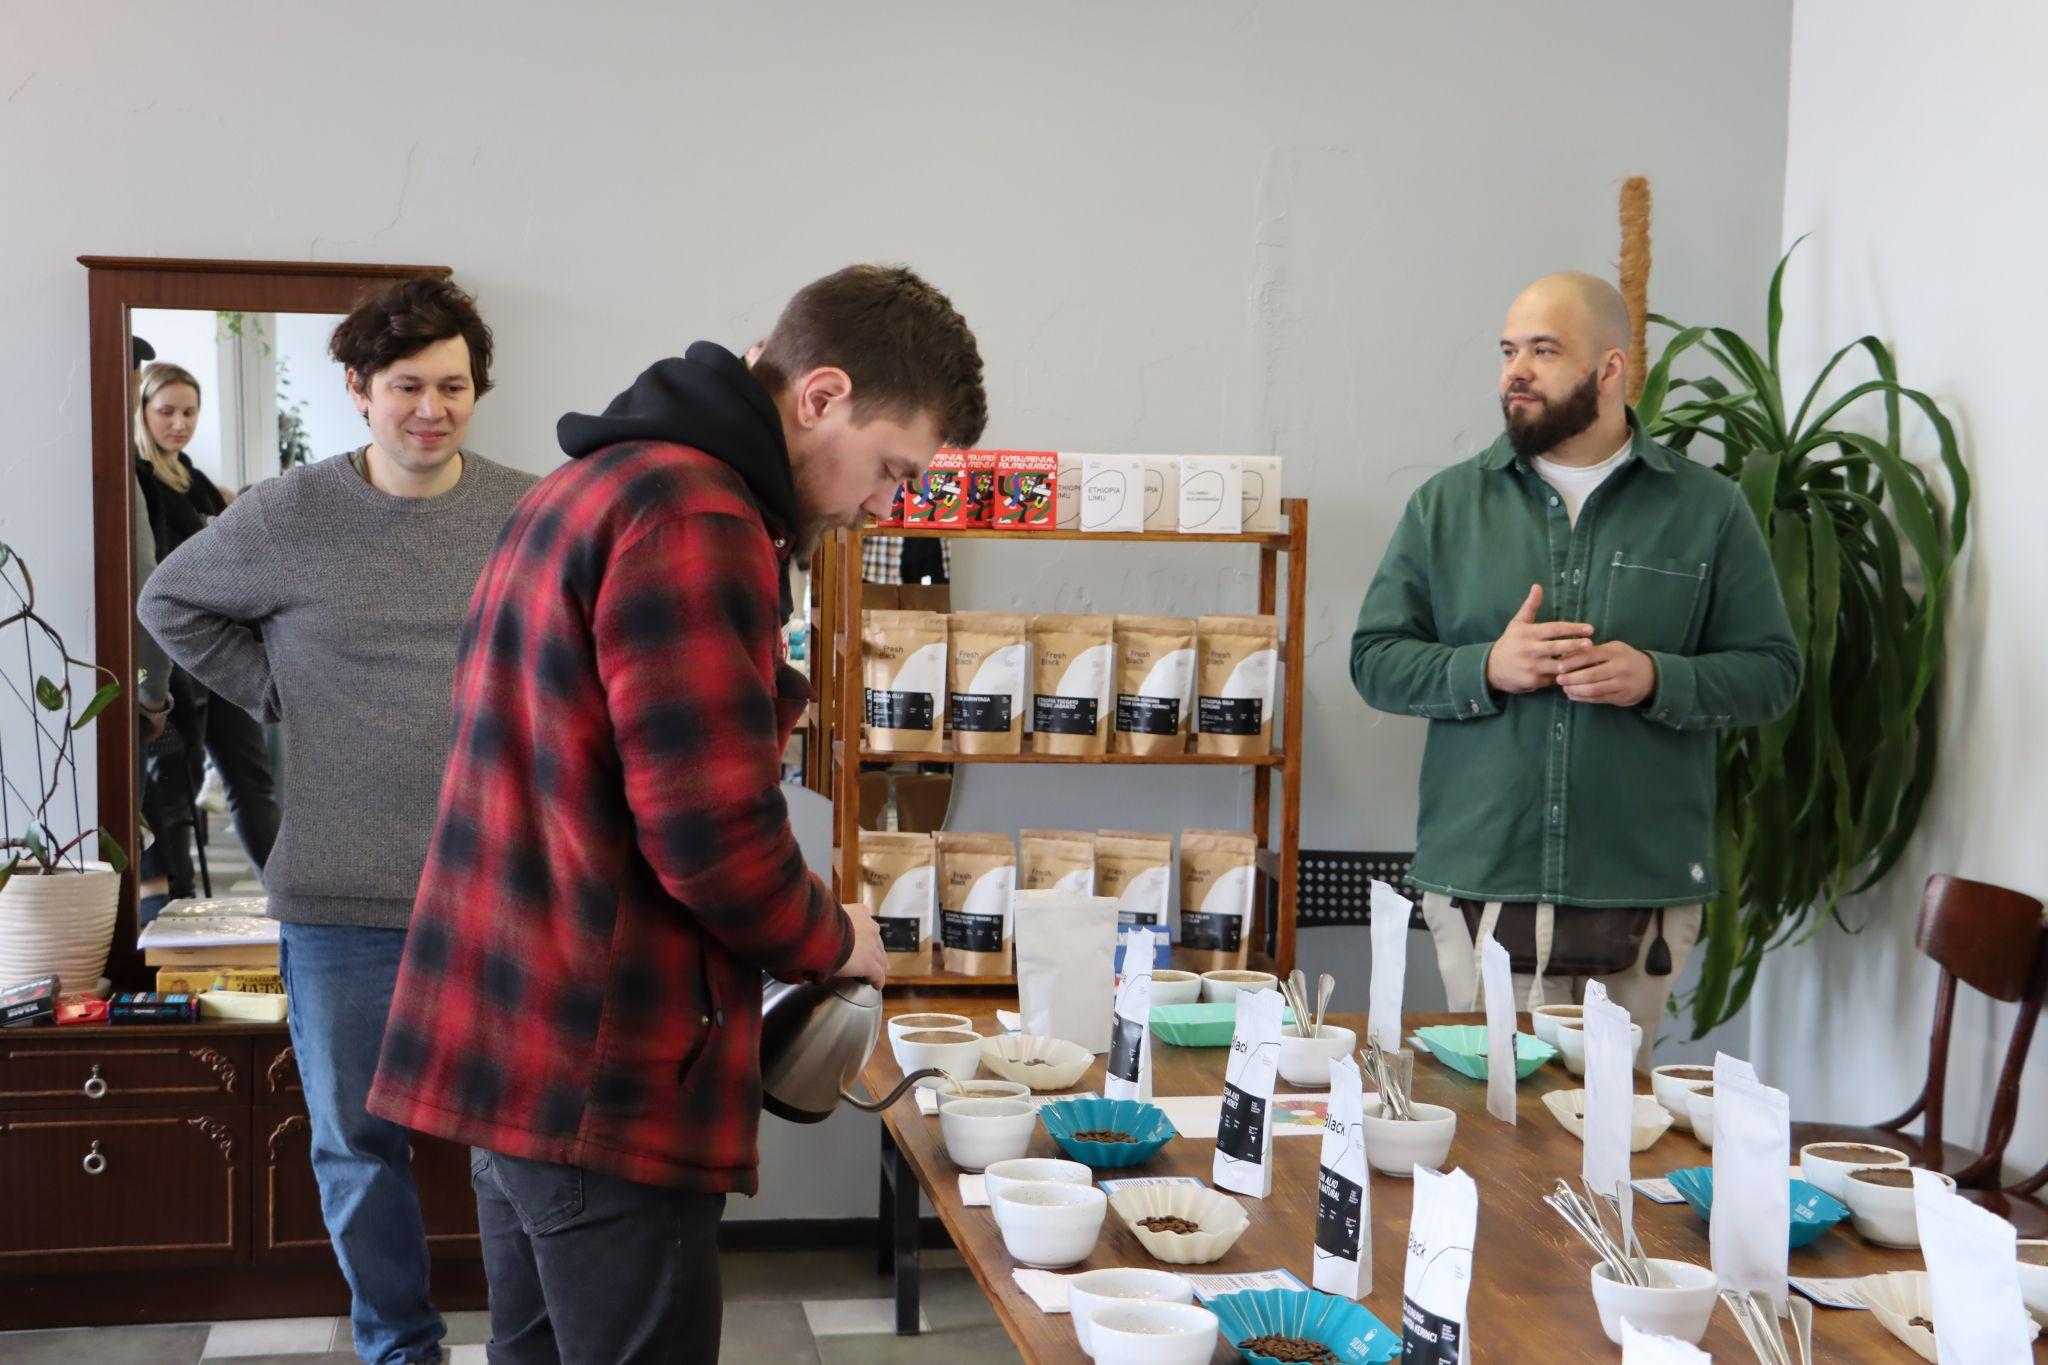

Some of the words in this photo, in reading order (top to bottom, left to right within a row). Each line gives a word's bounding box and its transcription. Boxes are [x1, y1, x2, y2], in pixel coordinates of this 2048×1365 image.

[1000, 455, 1055, 464] EXPERIMENTAL
[998, 462, 1057, 470] FERMENTATION
[1088, 486, 1121, 494] ETHIOPIA
[1088, 494, 1106, 502] LIMU
[883, 645, 904, 653] Fresh
[959, 650, 980, 659] Fresh
[1046, 651, 1067, 660] Fresh
[1211, 650, 1232, 659] Fresh
[1041, 658, 1060, 666] Black
[1325, 1175, 1339, 1190] ALKO
[1414, 1323, 1438, 1344] KERINCI
